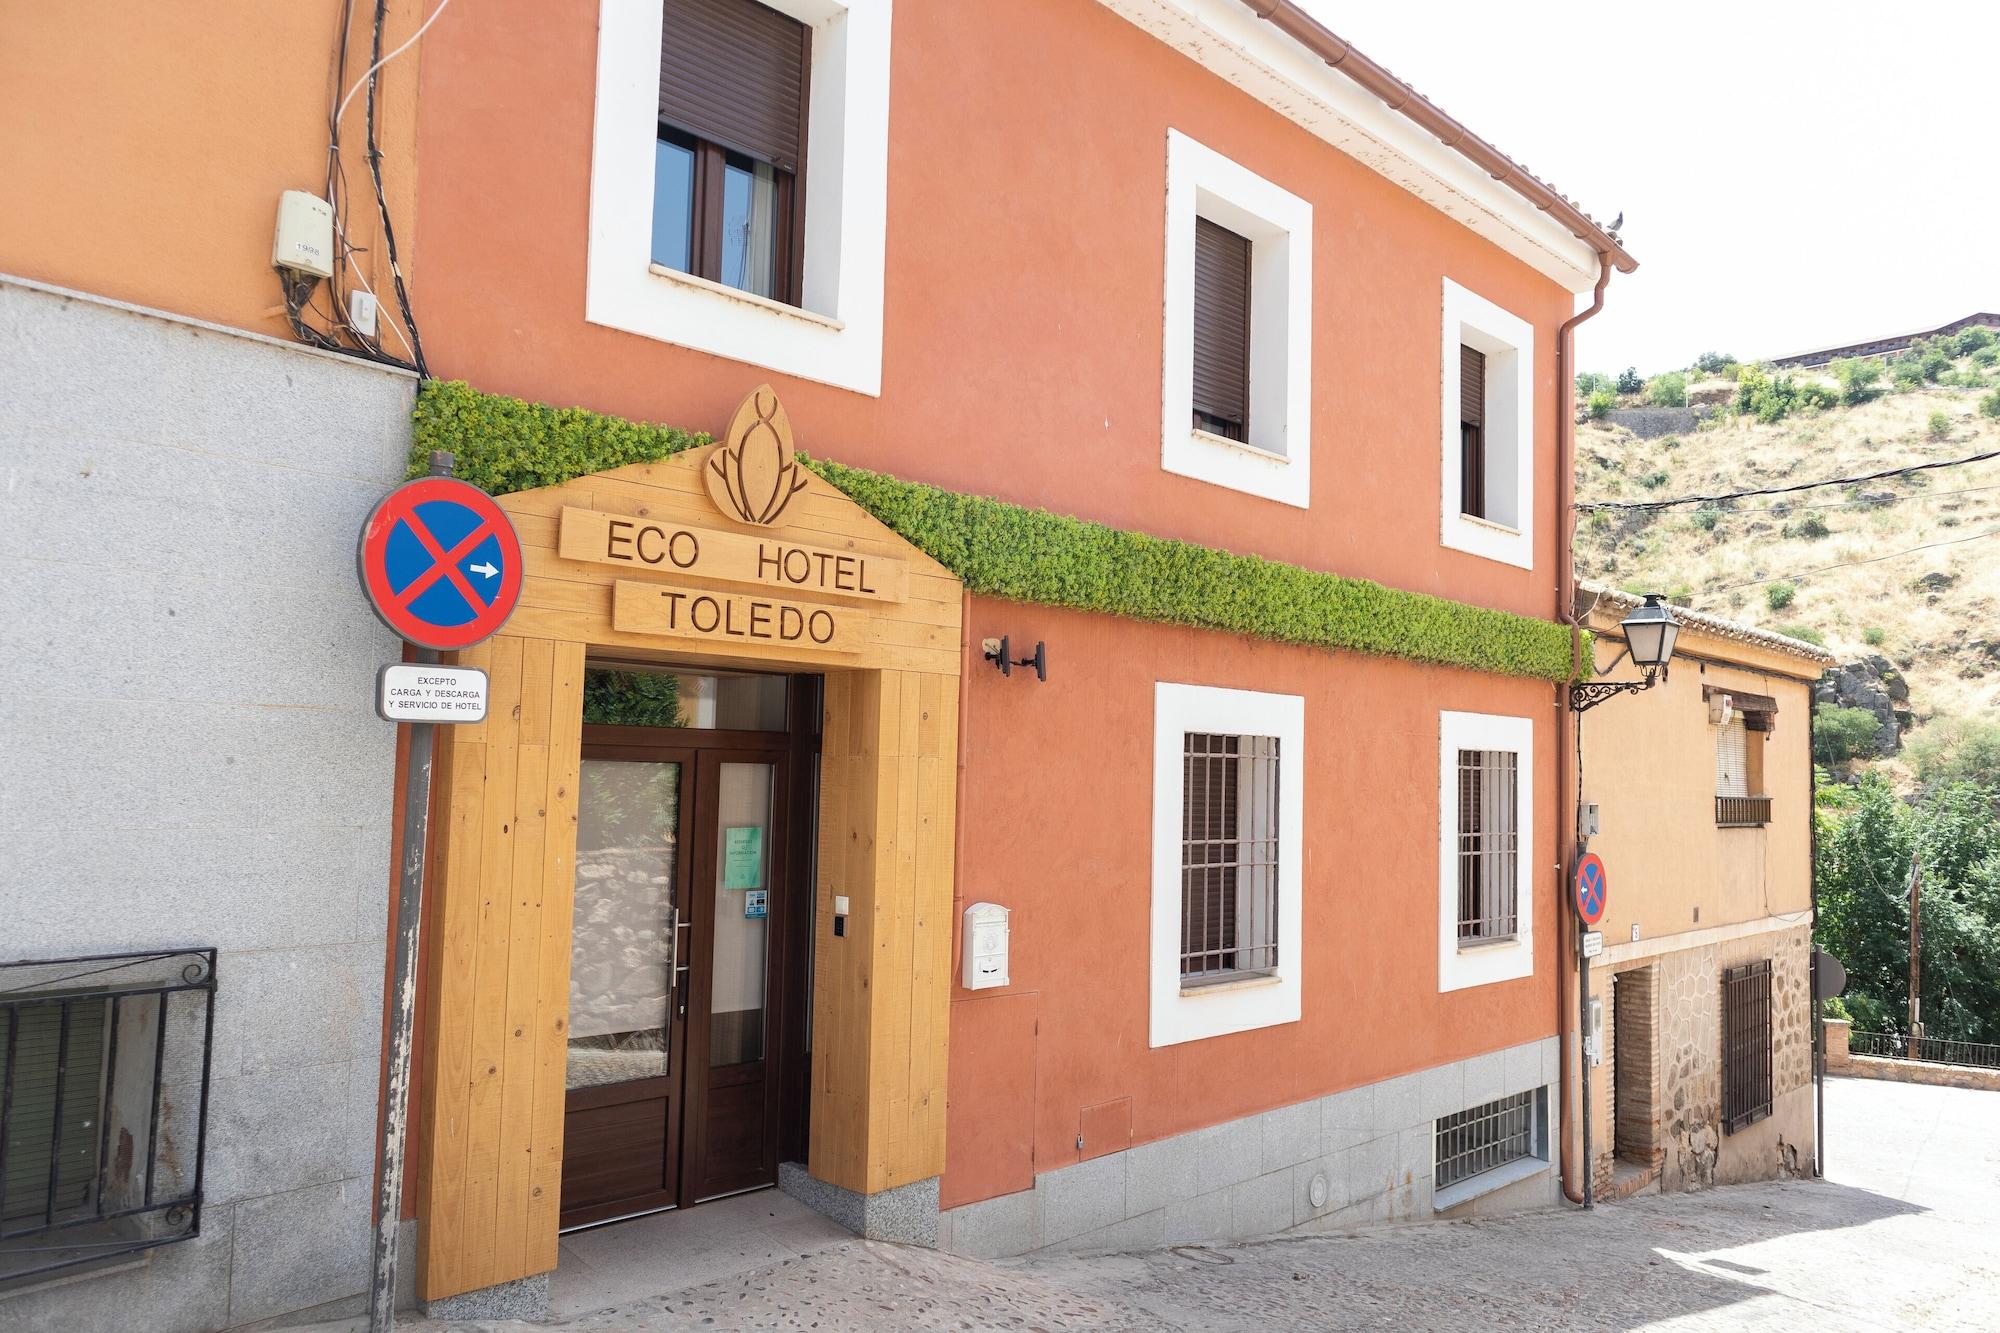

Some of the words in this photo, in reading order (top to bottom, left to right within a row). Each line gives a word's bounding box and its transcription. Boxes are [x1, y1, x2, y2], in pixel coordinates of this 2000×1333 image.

[607, 520, 700, 568] ECO
[758, 543, 876, 594] HOTEL
[661, 591, 835, 644] TOLEDO
[417, 677, 457, 686] EXCEPTO
[390, 688, 422, 697] CARGA
[425, 689, 431, 697] Y
[434, 689, 480, 699] DESCARGA
[388, 700, 395, 708] Y
[398, 700, 438, 710] SERVICIO
[441, 702, 452, 710] DE
[455, 702, 482, 711] HOTEL
